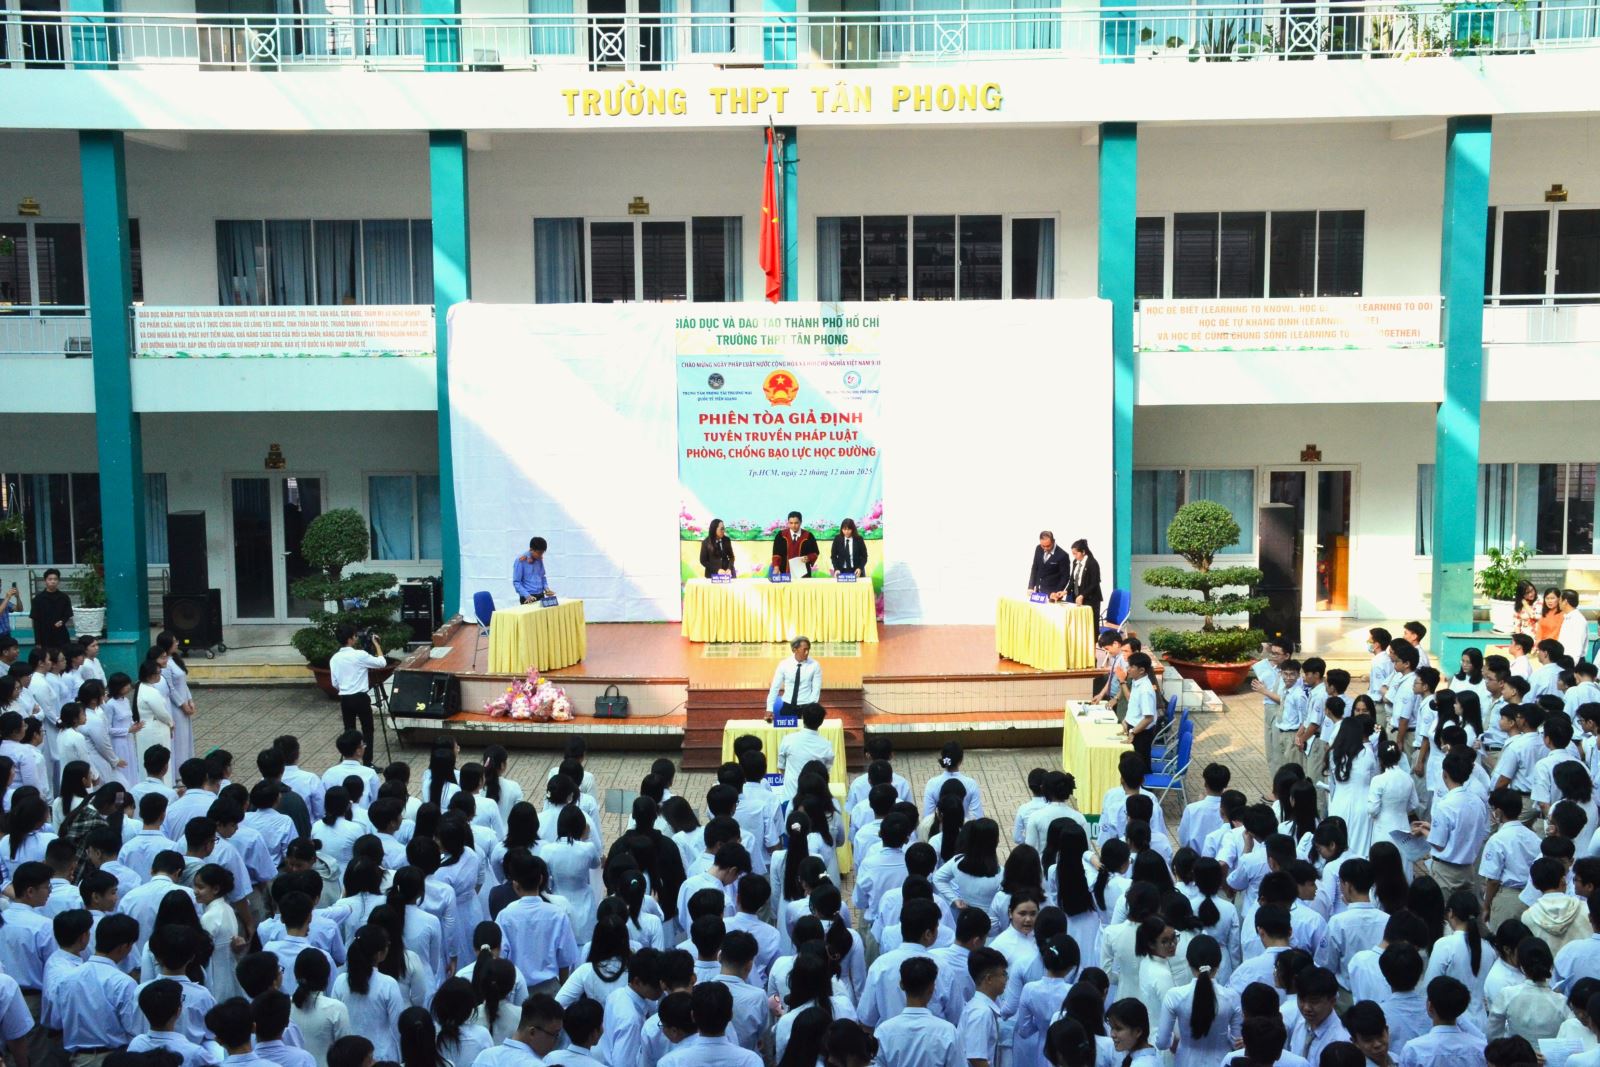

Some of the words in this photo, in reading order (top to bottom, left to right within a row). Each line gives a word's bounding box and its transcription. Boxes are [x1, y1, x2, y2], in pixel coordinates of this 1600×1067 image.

[561, 80, 687, 117] TRƯỜNG
[709, 85, 790, 114] THPT
[810, 80, 872, 113] TÂN
[891, 82, 1003, 112] PHONG
[1251, 304, 1260, 313] TO
[1405, 302, 1415, 311] TO
[700, 318, 719, 332] DỤC
[723, 316, 735, 328] VÀ
[784, 316, 819, 328] THÀNH
[822, 314, 843, 328] PHỐ
[716, 332, 757, 345] TRƯỜNG
[761, 335, 787, 345] THPT
[792, 332, 810, 345] TÂN
[814, 334, 848, 345] PHONG
[699, 410, 749, 425] PHIÊN
[753, 410, 784, 424] TÒA
[788, 409, 816, 424] GIẢ
[820, 412, 863, 426] ĐỊNH
[704, 430, 742, 442] TUYÊN
[745, 428, 792, 441] TRUYỀN
[795, 429, 827, 441] PHÁP
[830, 428, 858, 443] LUẬT
[686, 445, 726, 460] PHÒNG,
[728, 444, 766, 458] CHỐNG
[768, 448, 789, 460] BẠO
[792, 447, 811, 460] LỰC
[814, 448, 835, 460] HỌC
[838, 444, 876, 457] ĐƯỜNG
[809, 468, 828, 476] tháng
